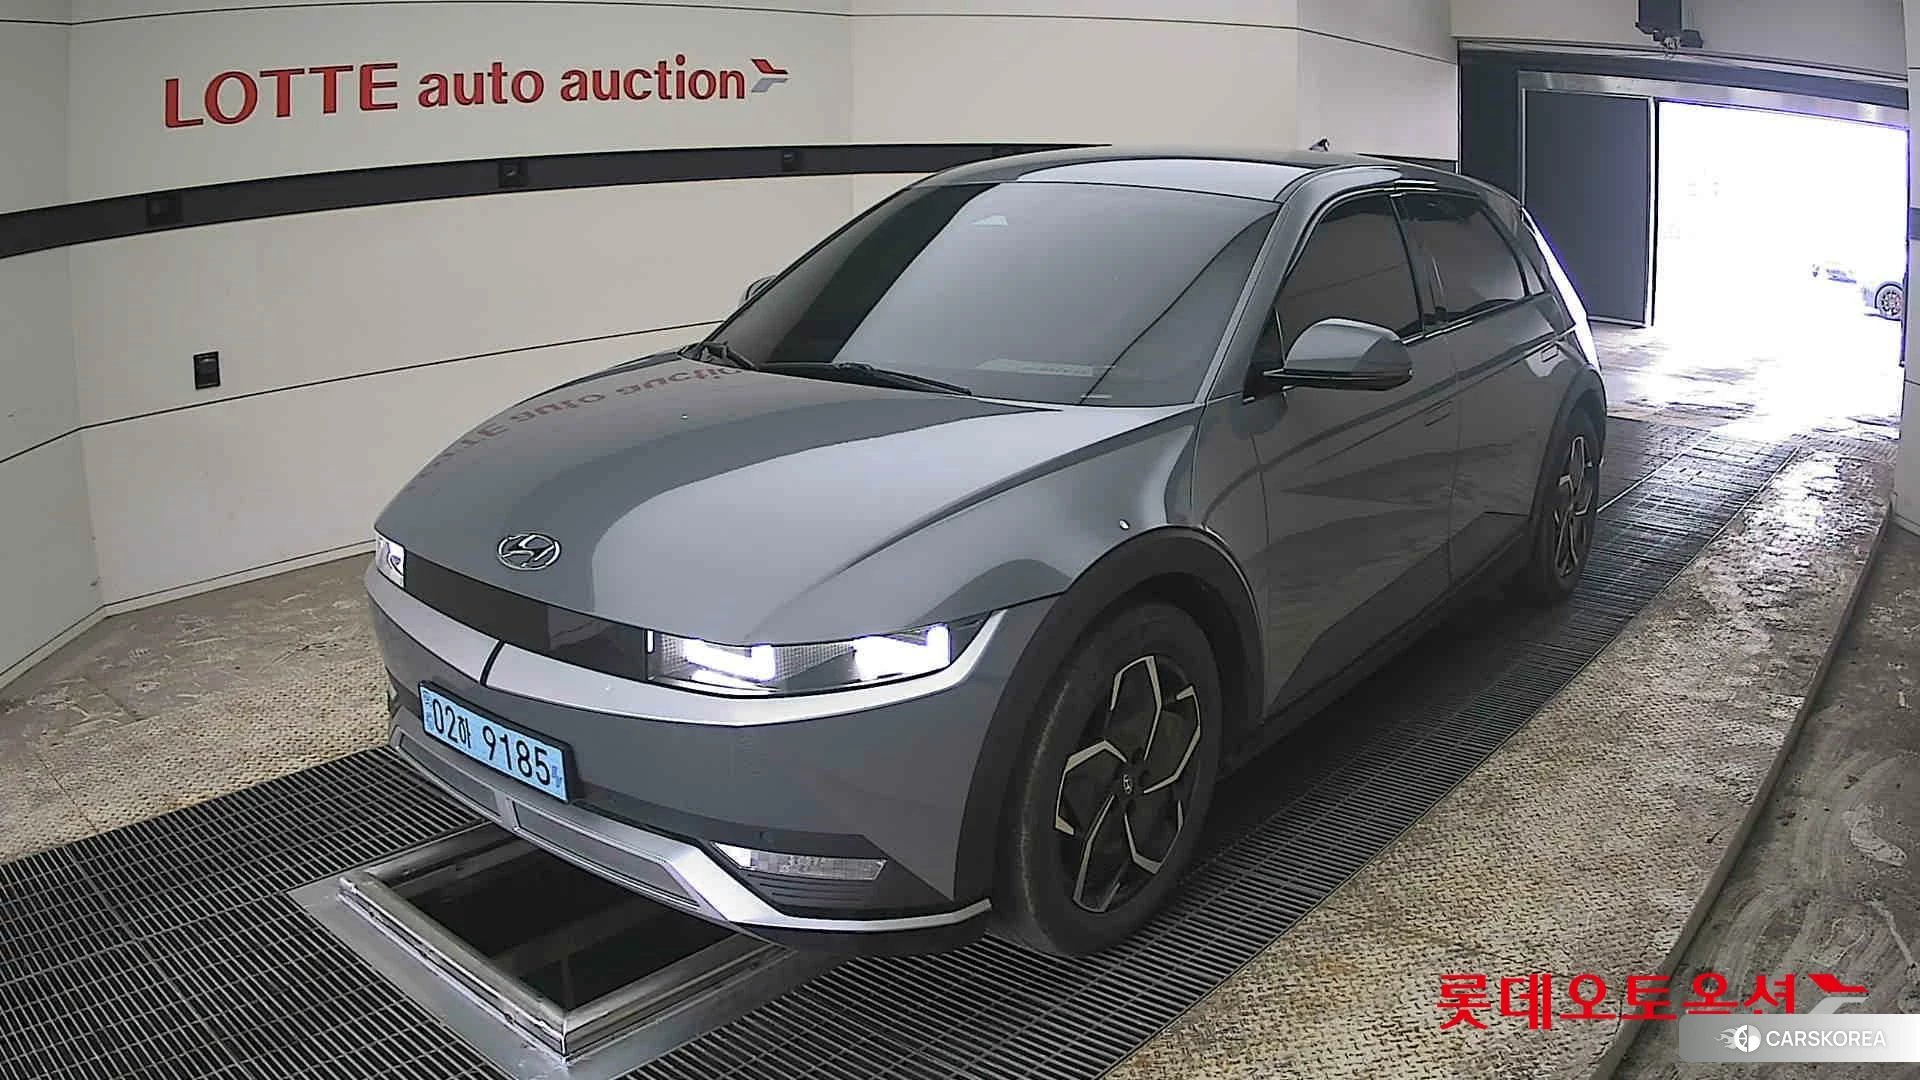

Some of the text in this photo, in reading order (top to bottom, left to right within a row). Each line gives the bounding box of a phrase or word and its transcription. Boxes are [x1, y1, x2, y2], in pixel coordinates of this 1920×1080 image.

[164, 54, 745, 128] LOTTE auto auction
[482, 725, 551, 786] 9185
